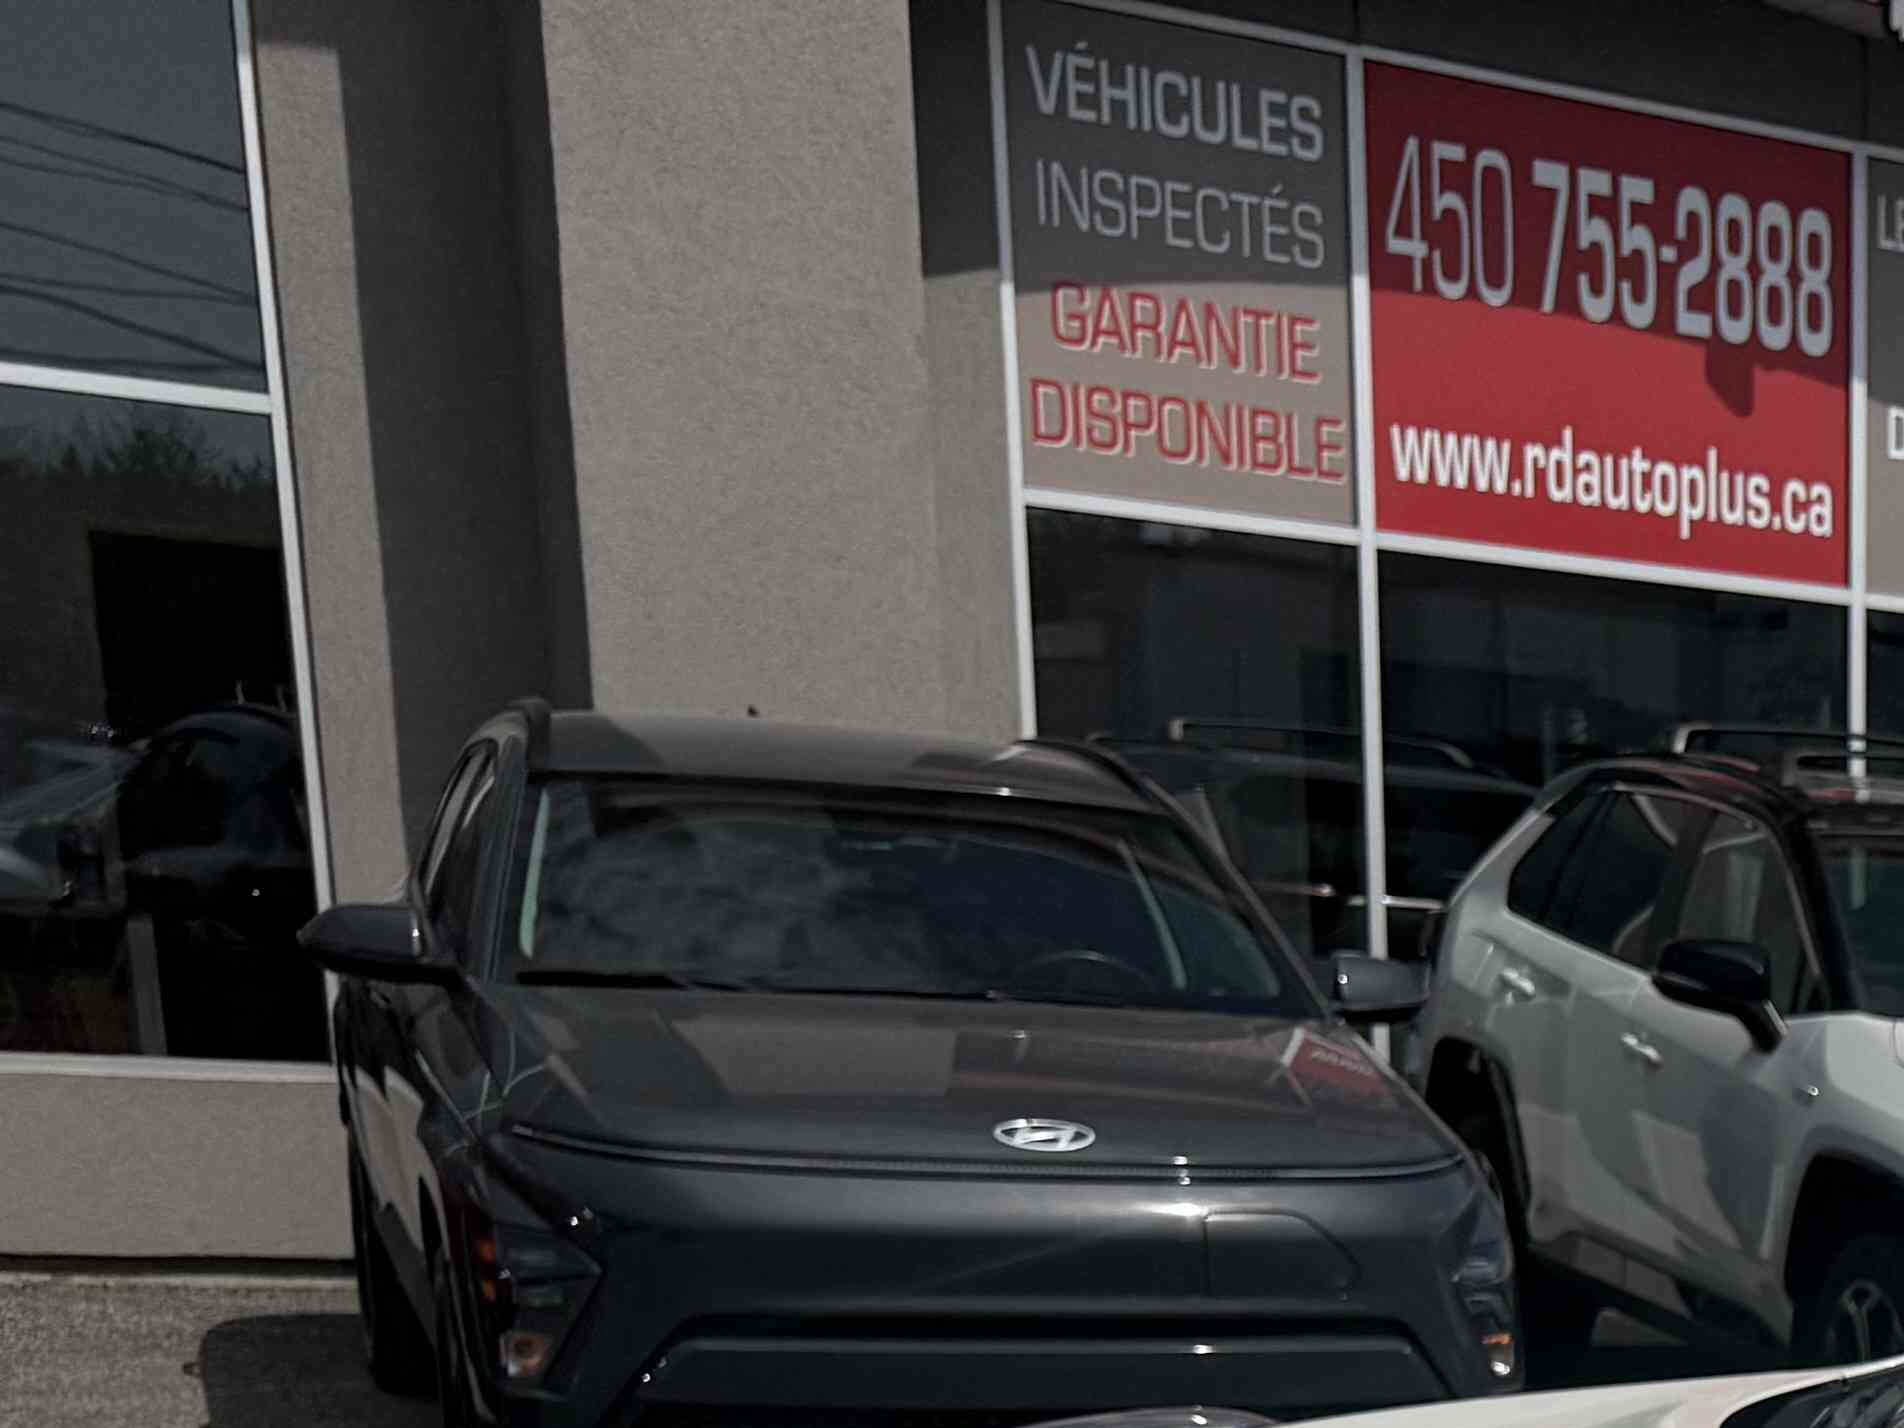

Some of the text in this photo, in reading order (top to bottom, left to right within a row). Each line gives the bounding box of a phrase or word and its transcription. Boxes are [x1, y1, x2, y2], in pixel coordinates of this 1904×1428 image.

[1025, 43, 1324, 160] VÉHICULES
[1036, 160, 1325, 268] INSPECTÉS
[1386, 136, 1833, 357] 450 755-2888
[1051, 282, 1322, 384] GARANTIE
[1030, 378, 1345, 485] DISPONIBLE
[1390, 422, 1834, 538] www.rdautoplus.ca
